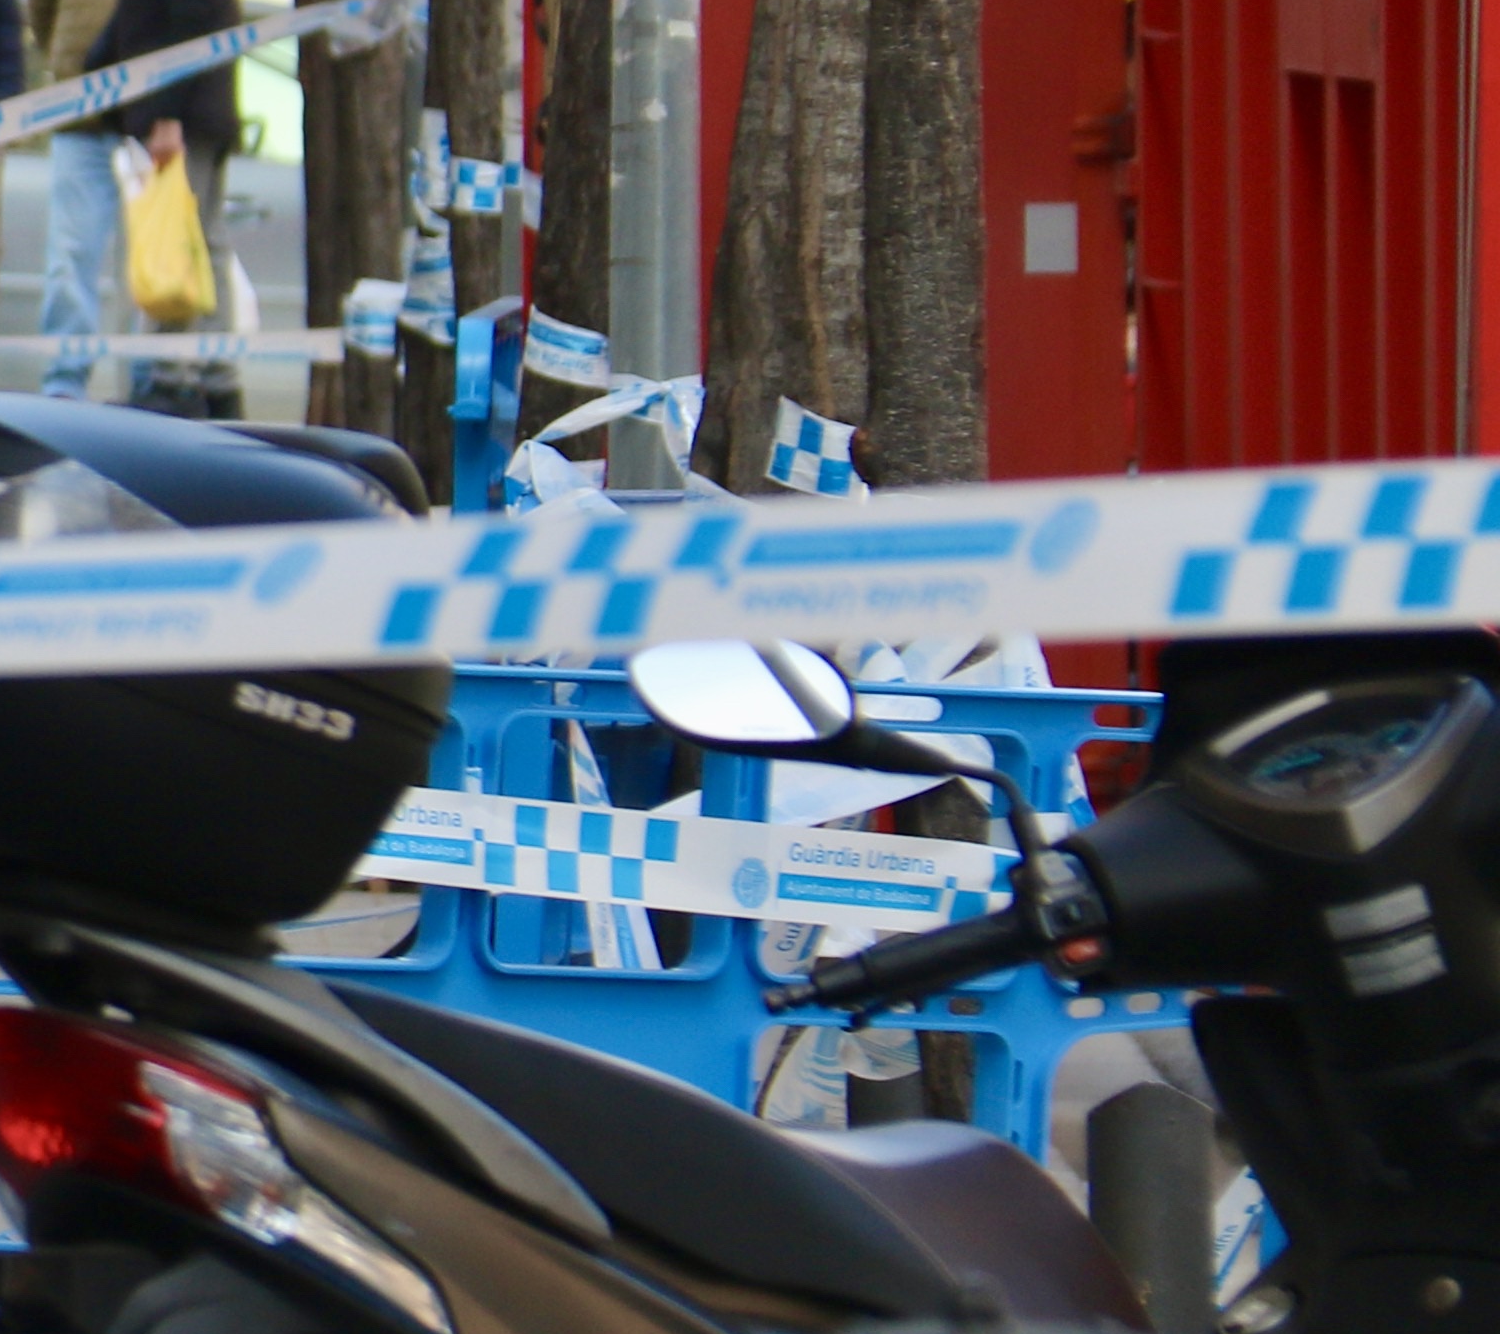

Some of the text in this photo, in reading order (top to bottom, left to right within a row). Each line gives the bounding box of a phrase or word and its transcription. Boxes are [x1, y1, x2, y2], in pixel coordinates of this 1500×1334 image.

[788, 841, 936, 876] Guàrdia Urbana
[785, 880, 932, 906] Ajuntament de Badalona
